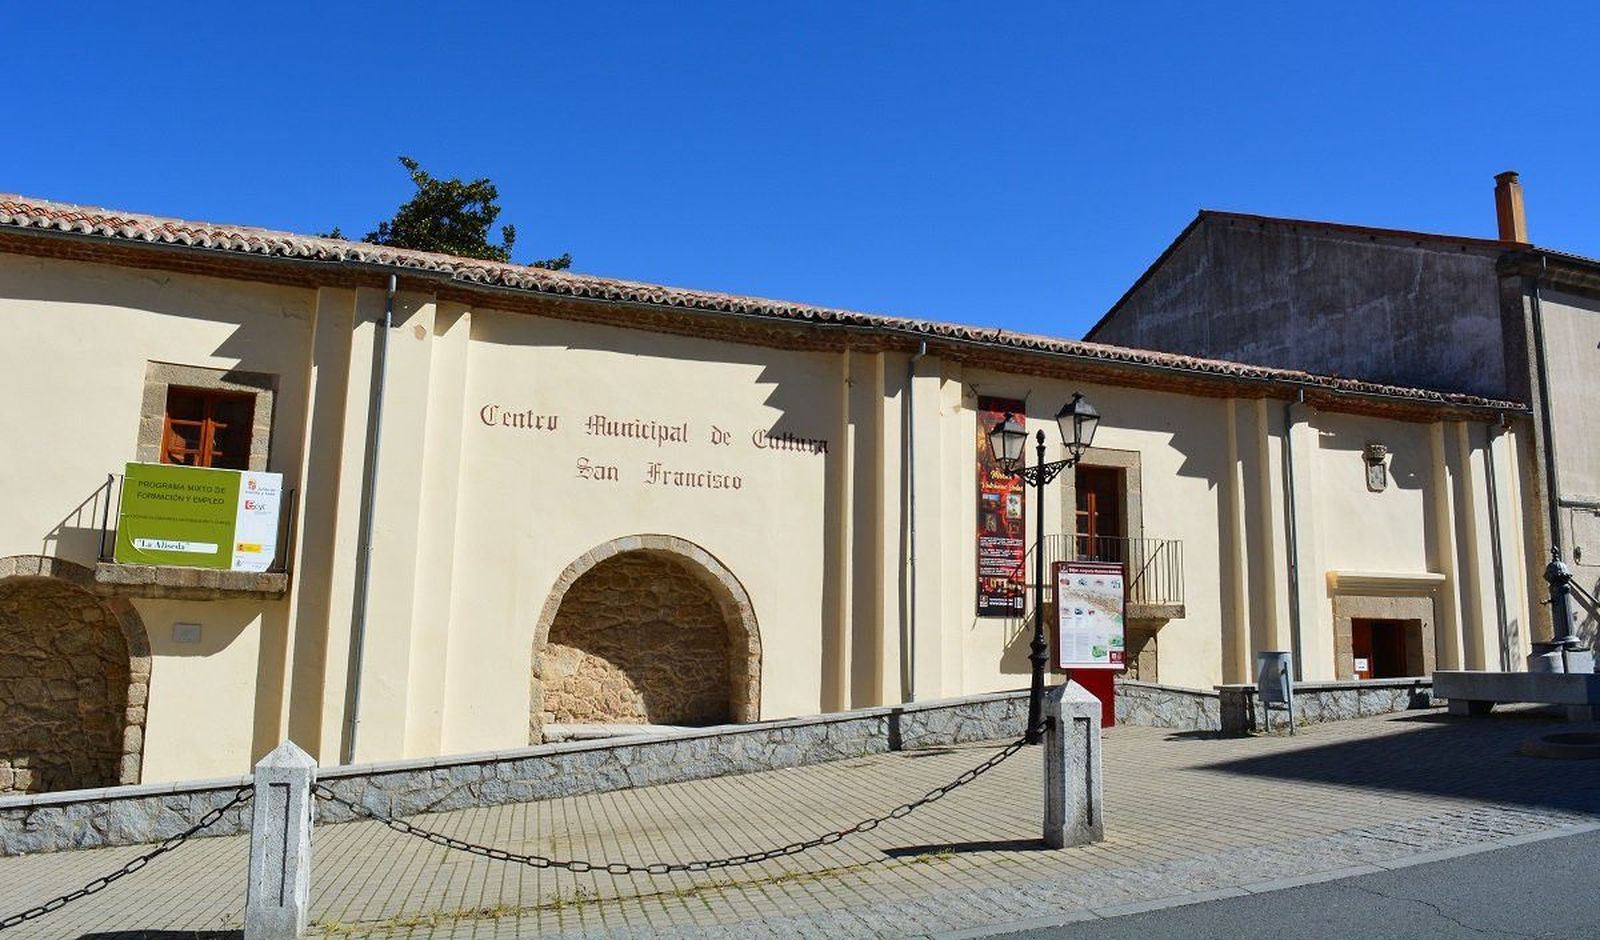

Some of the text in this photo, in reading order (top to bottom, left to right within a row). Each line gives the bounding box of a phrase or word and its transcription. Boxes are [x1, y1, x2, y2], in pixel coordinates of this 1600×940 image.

[479, 404, 830, 456] Centro Municipal de Cultura
[576, 456, 743, 491] San Francisco
[138, 480, 225, 495] PROGRAMA MIXTO DE
[192, 496, 225, 505] EMPLEO
